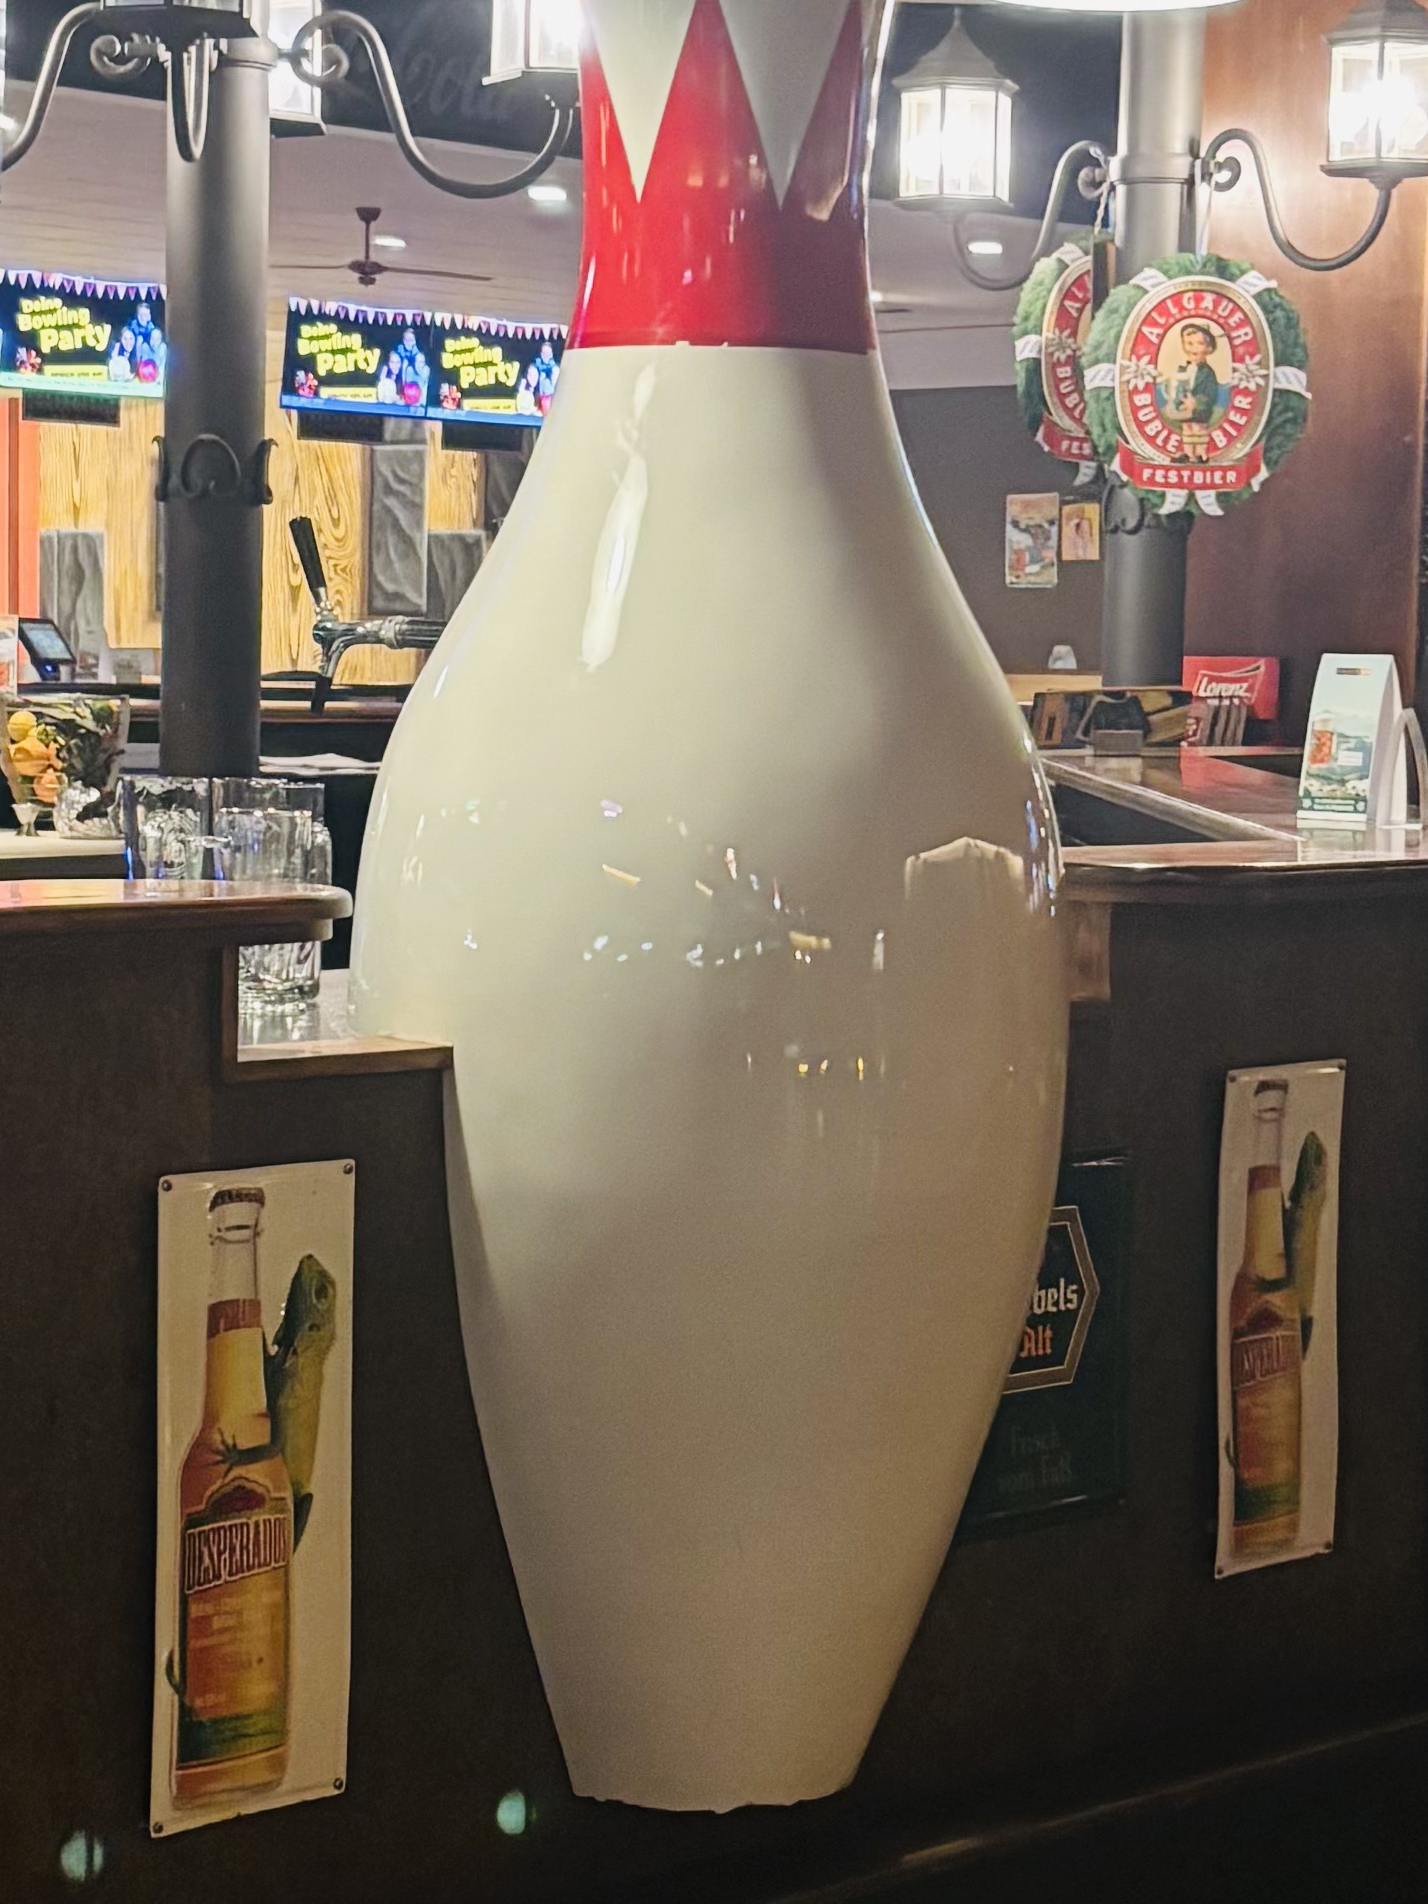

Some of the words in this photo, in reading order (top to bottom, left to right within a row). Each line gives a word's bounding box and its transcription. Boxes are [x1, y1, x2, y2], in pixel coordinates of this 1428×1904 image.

[16, 307, 91, 332] Bowling
[39, 324, 113, 354] Party
[316, 348, 381, 377] Party
[459, 361, 521, 389] Party
[1211, 394, 1253, 449] BIER
[1142, 467, 1238, 485] FESTBIER
[1199, 676, 1252, 698] Lorenz
[1031, 1277, 1079, 1315] bels
[1019, 1324, 1054, 1358] Alt
